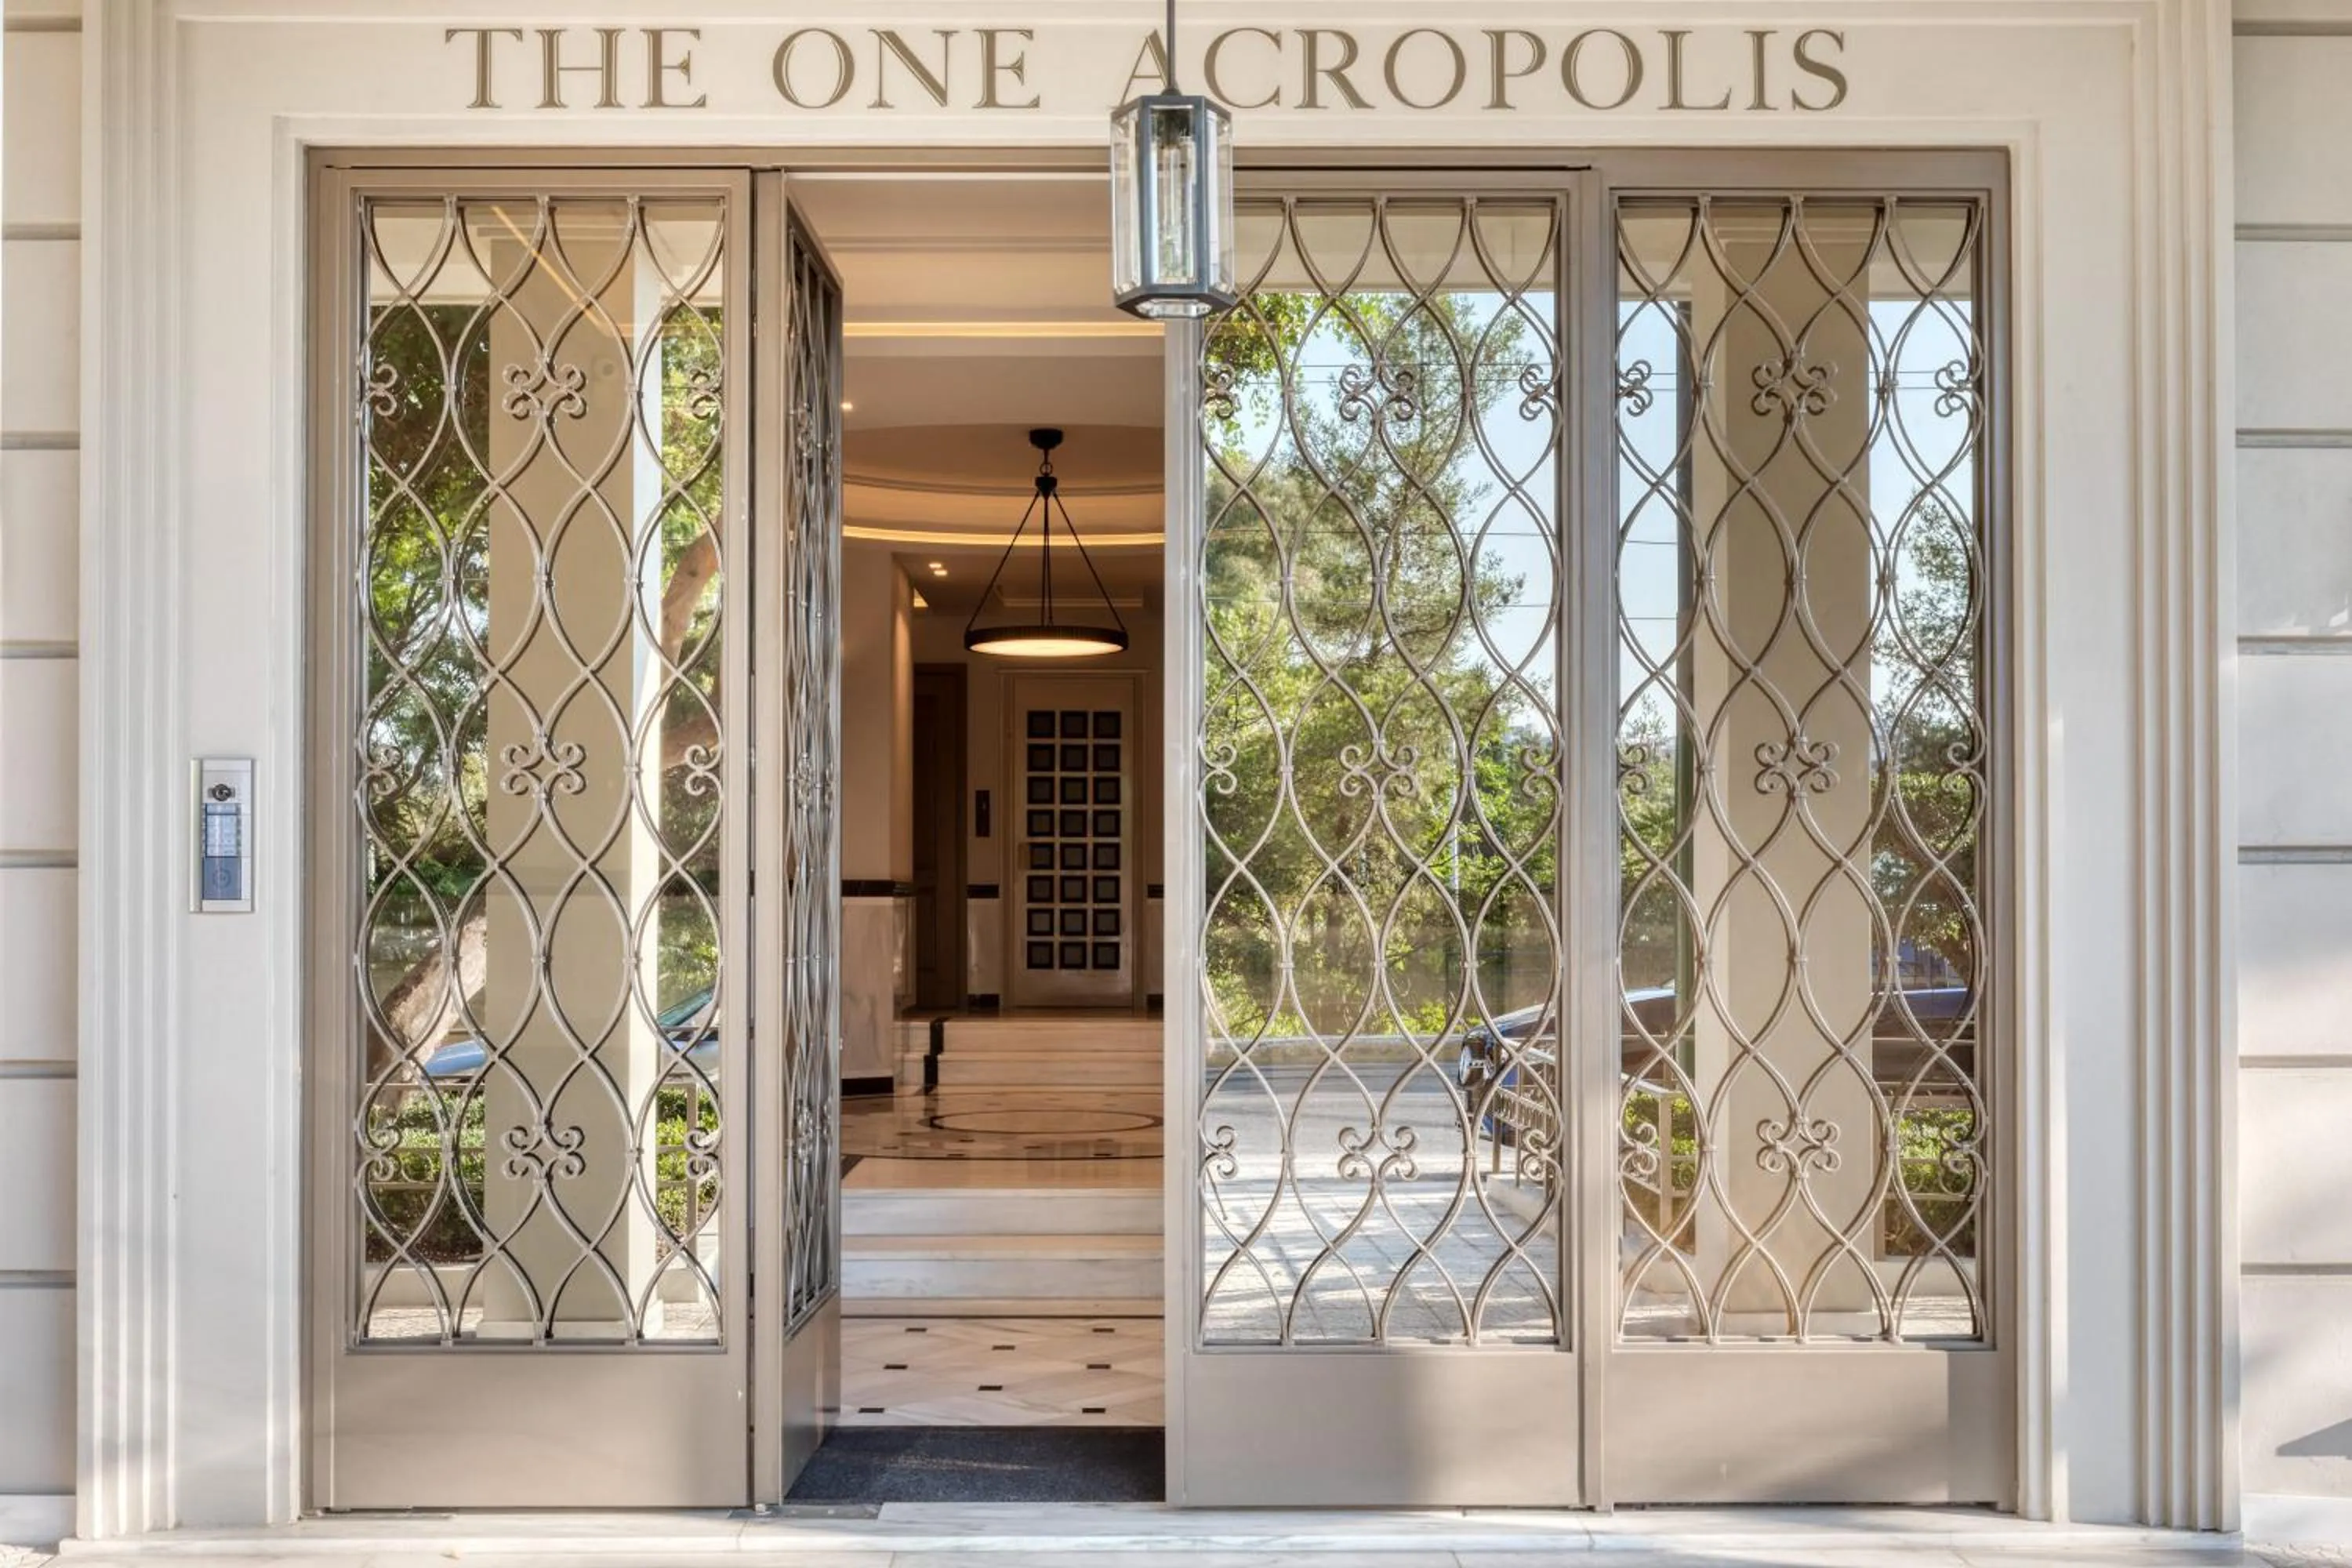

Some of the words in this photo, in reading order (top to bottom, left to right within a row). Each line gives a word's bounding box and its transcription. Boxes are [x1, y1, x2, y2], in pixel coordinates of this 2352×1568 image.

[445, 28, 706, 108] THE
[772, 27, 1040, 108] ONE
[1109, 27, 1849, 111] ACROPOLIS
